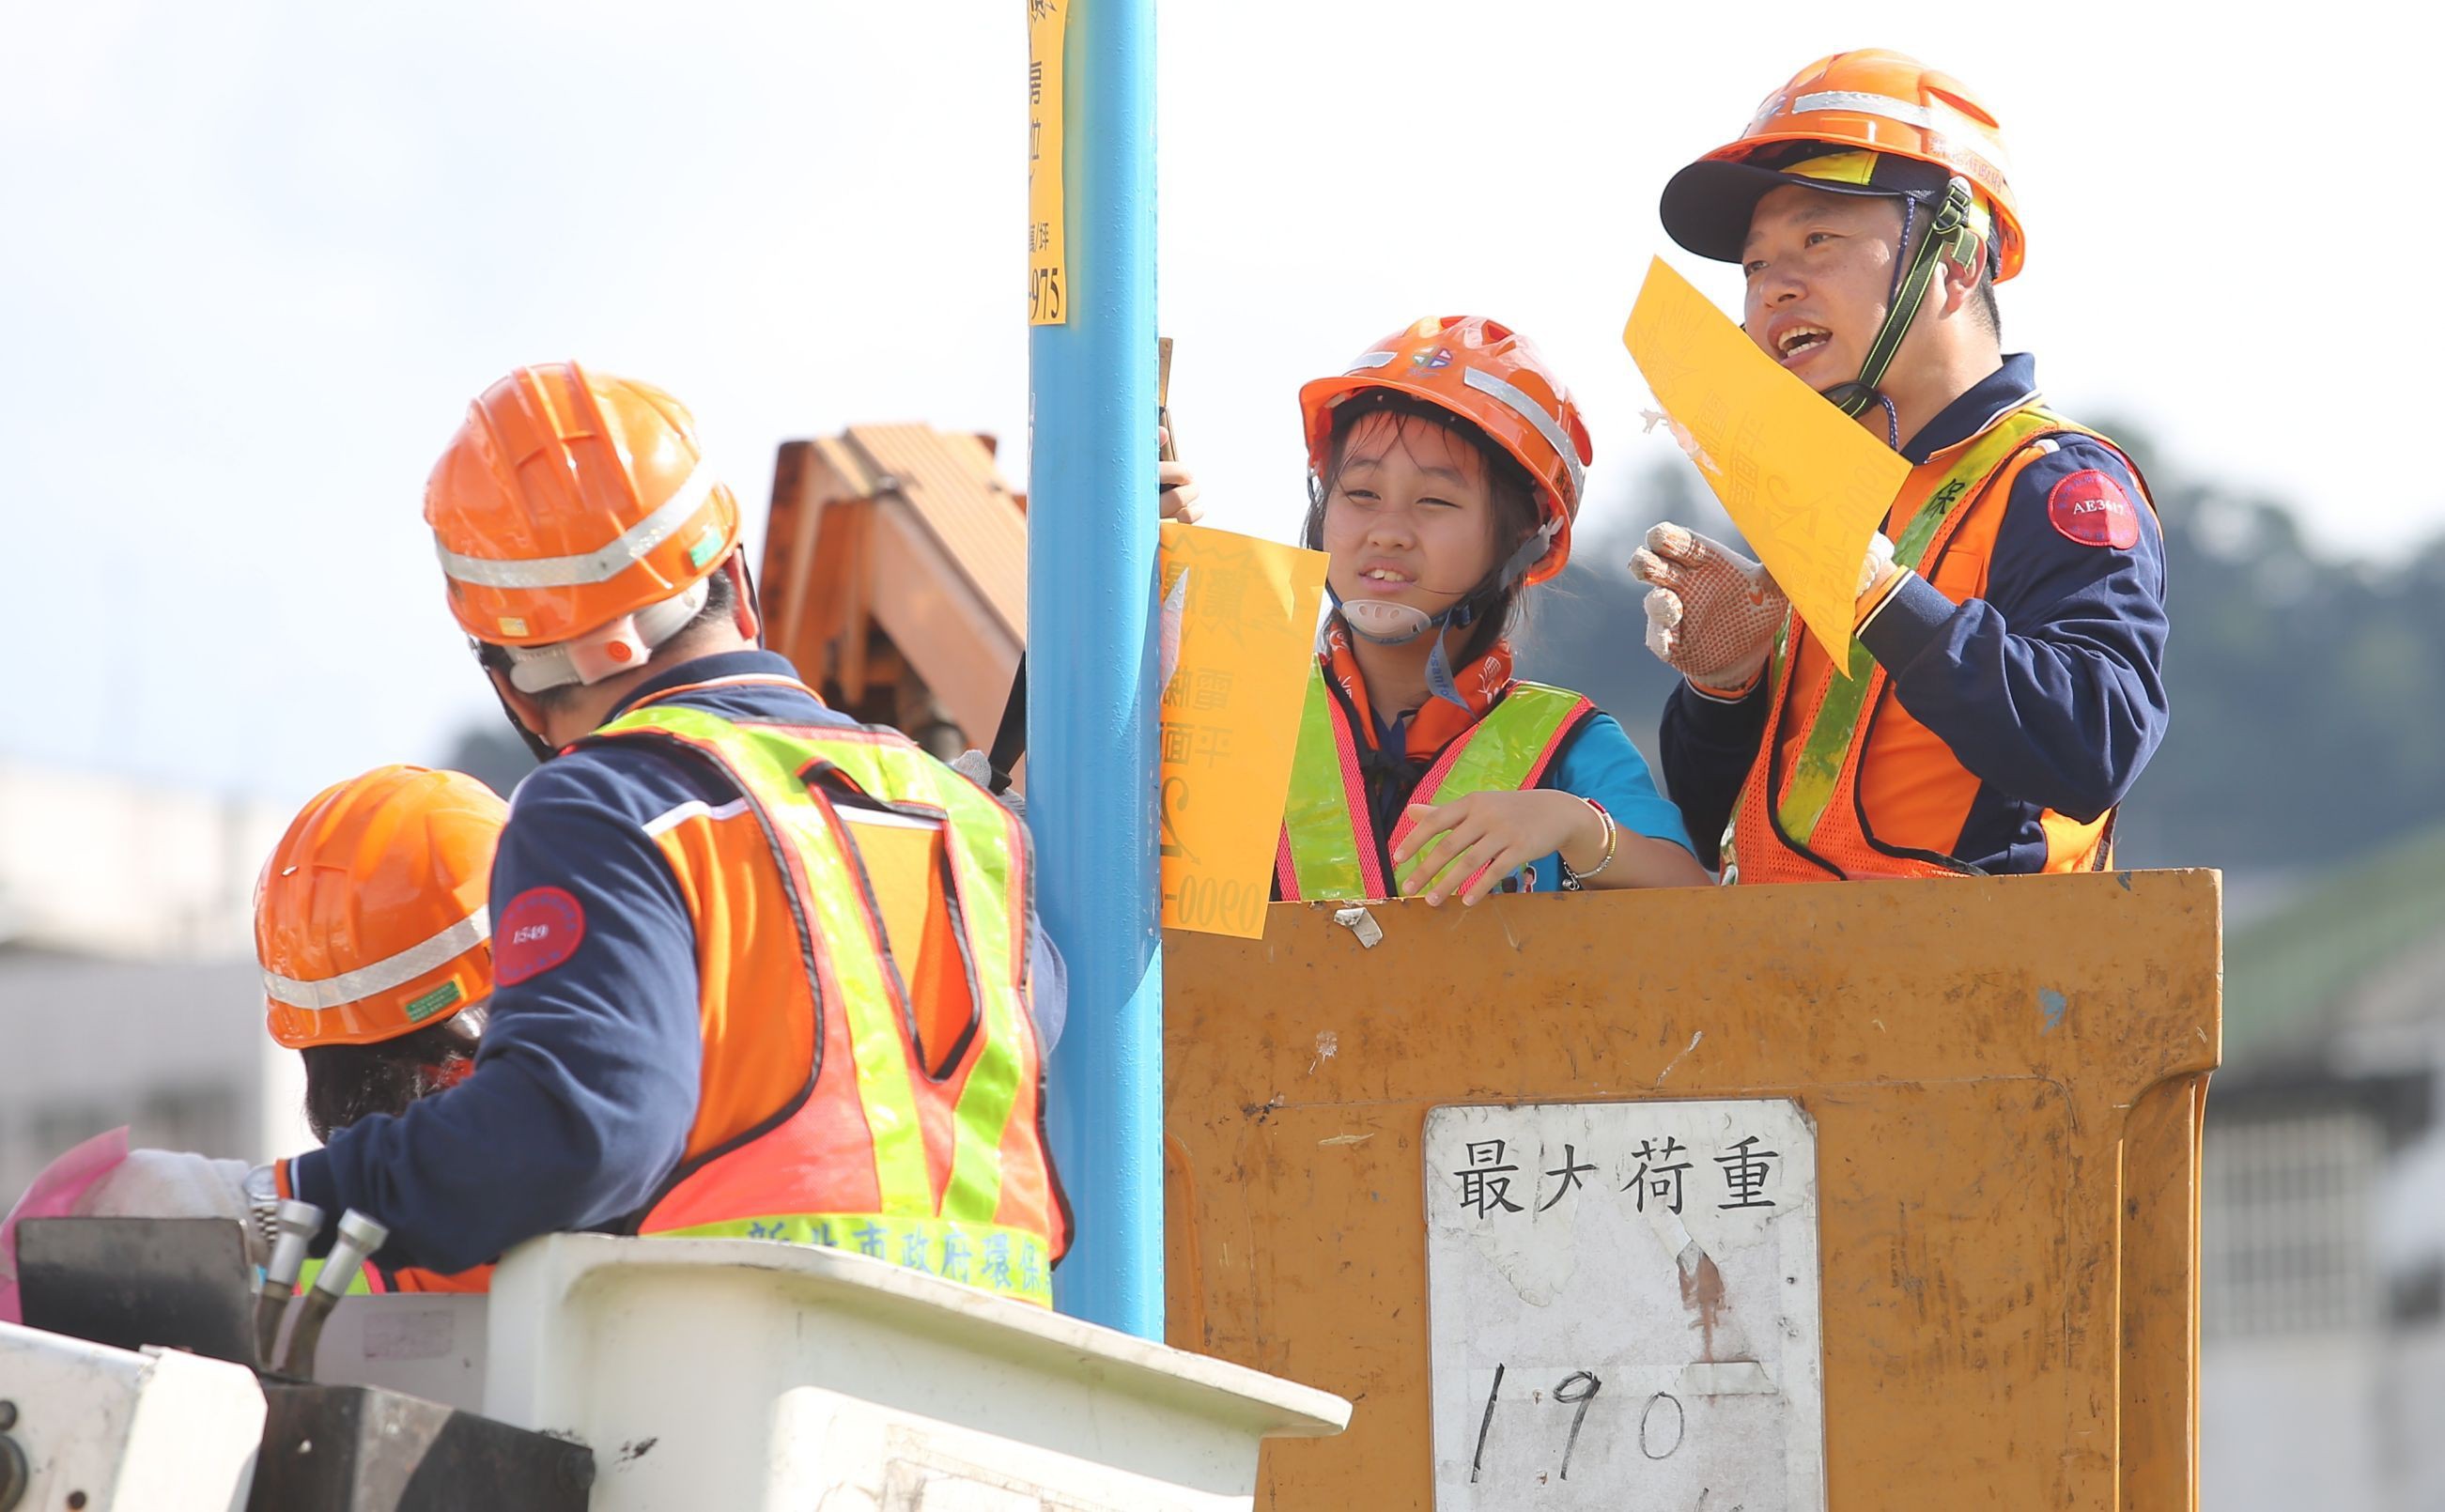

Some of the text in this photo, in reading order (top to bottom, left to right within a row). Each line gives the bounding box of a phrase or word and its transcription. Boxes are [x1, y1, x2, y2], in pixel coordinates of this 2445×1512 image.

[1453, 1134, 1779, 1220] 最大荷重
[1470, 1363, 1684, 1484] 190
